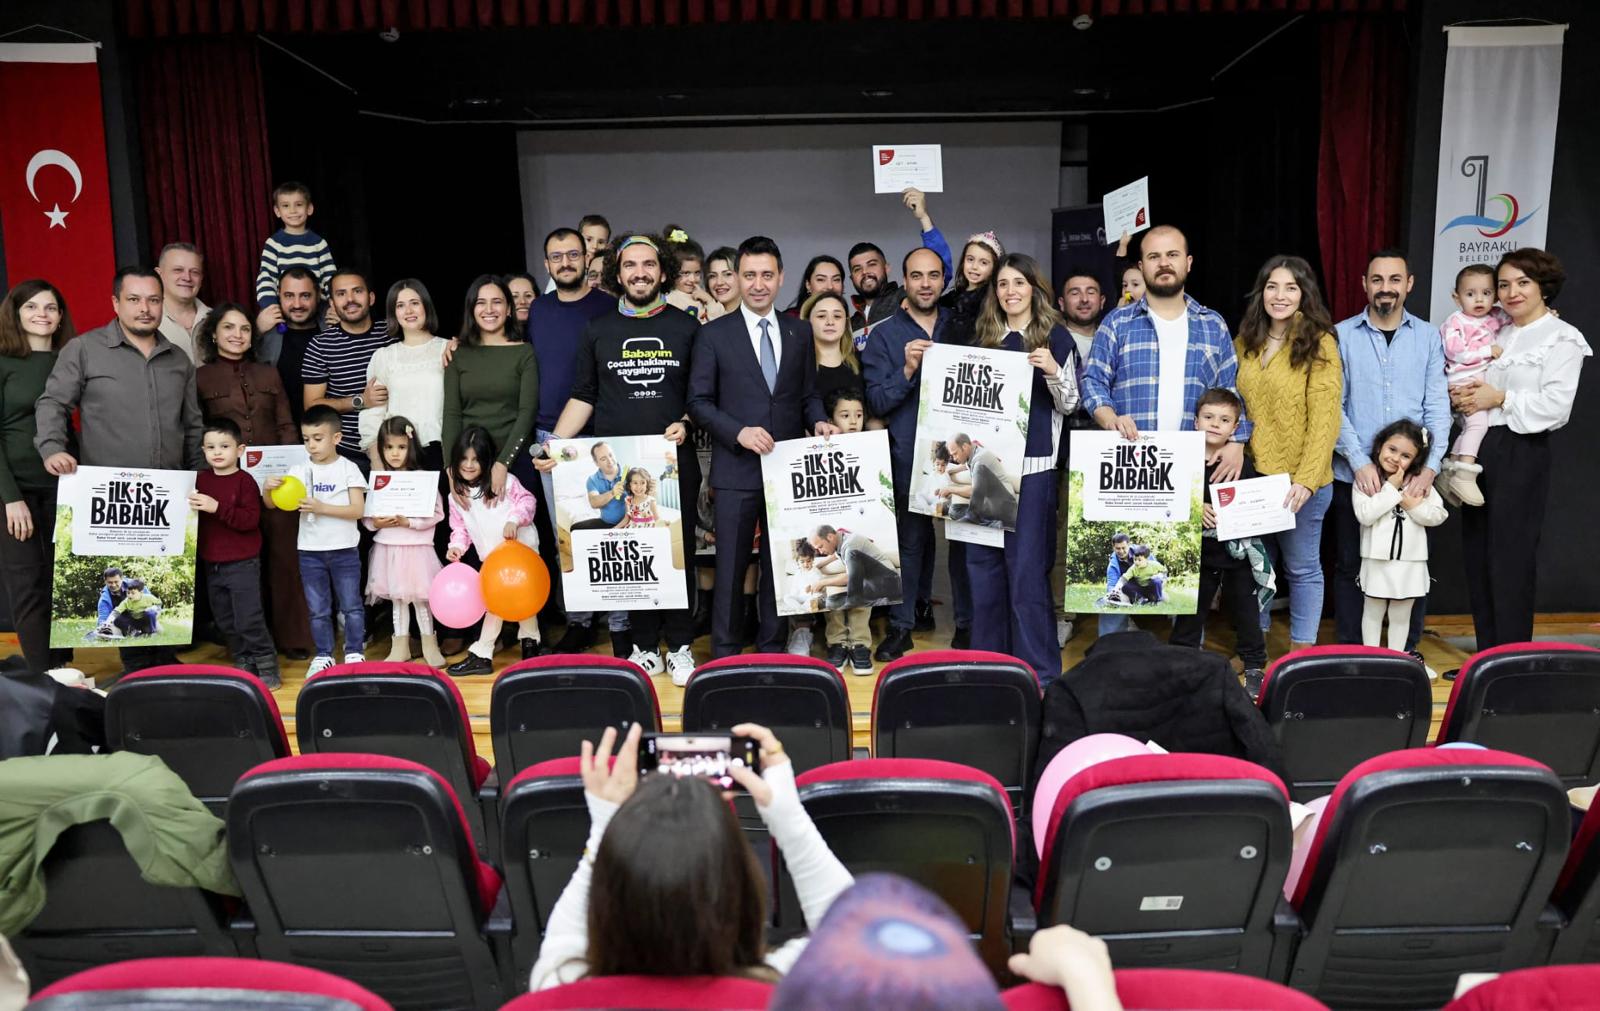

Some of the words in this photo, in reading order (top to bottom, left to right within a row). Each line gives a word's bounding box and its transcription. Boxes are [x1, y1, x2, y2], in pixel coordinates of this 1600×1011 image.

[1459, 241, 1517, 253] BAYRAKLI
[607, 359, 636, 369] Çocuk
[637, 358, 680, 367] haklarına
[622, 349, 672, 358] Babayım
[617, 367, 665, 376] saygılıyım
[942, 376, 1004, 410] BABALIK
[791, 466, 865, 499] BABALIK
[1099, 462, 1174, 491] BABALIK
[90, 497, 170, 526] BABALIK
[588, 555, 659, 583] BABALIK
